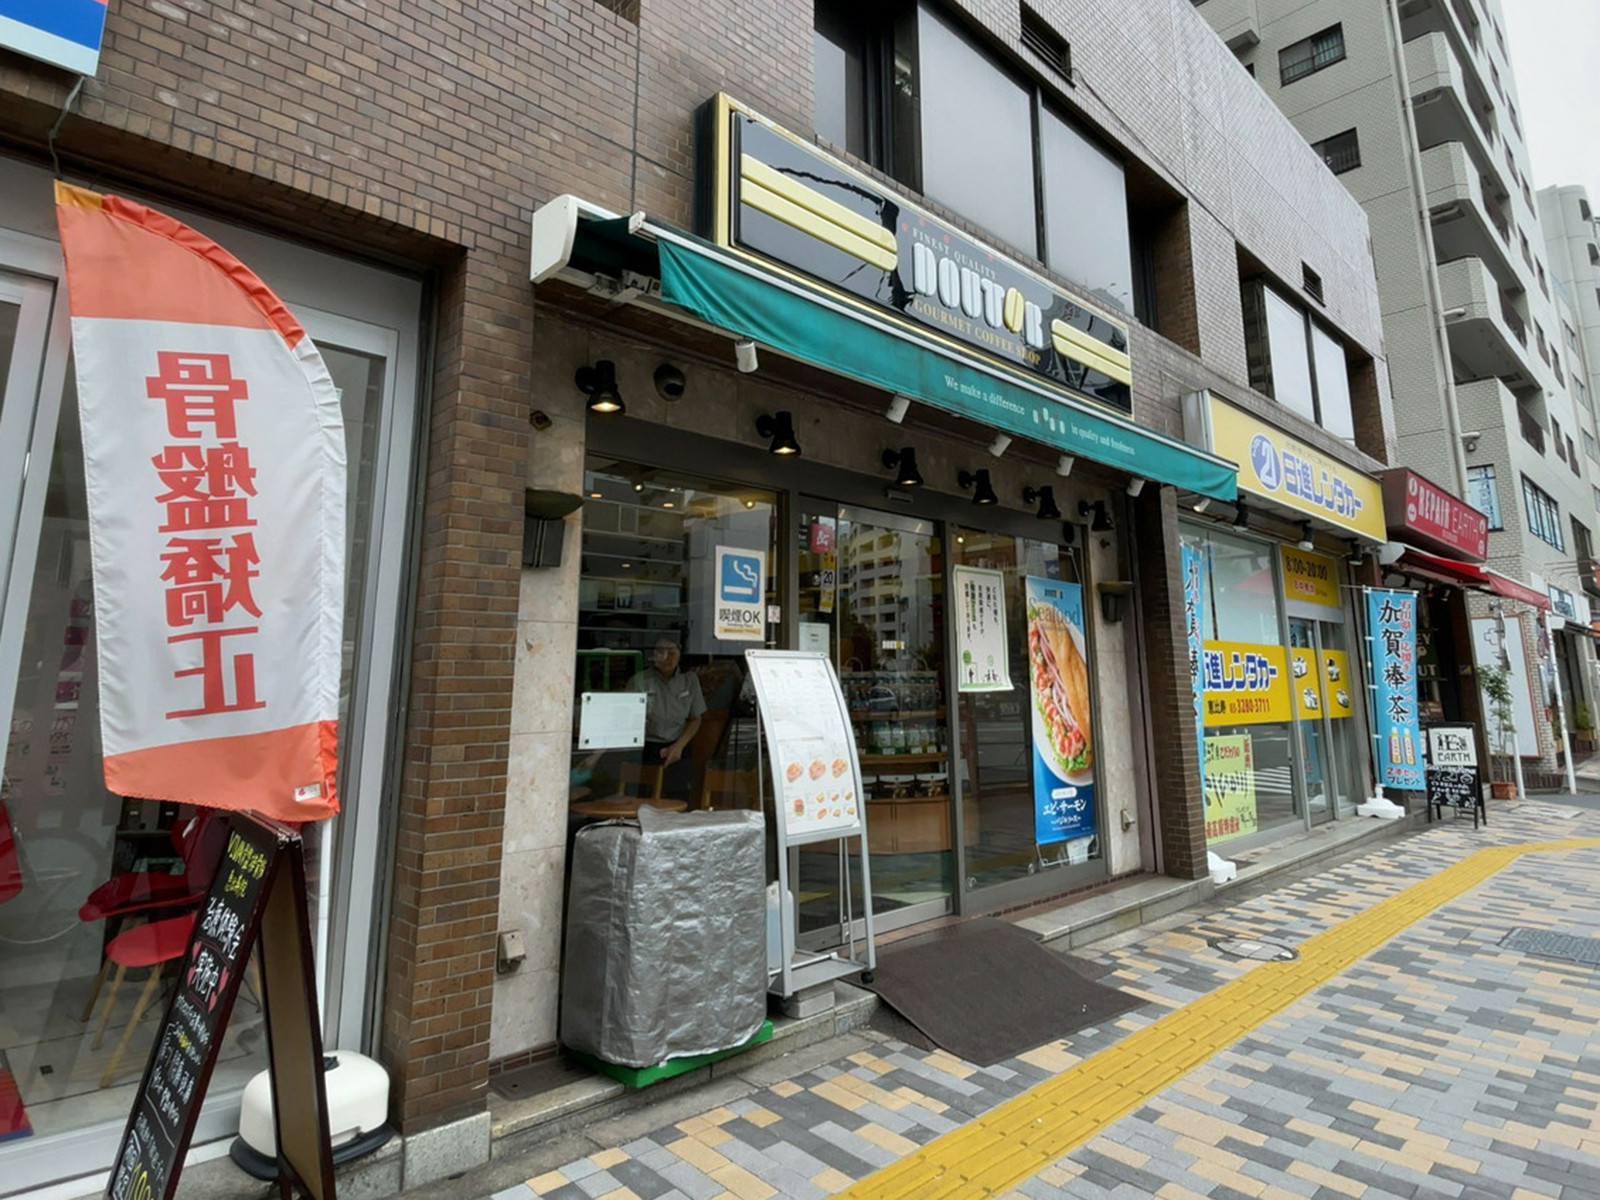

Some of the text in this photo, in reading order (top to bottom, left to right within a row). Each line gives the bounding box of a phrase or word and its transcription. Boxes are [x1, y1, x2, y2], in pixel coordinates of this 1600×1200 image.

[913, 228, 996, 280] FINEST QUALITY
[913, 242, 1043, 348] DOUTOR
[914, 301, 971, 334] GOURMET
[975, 328, 1014, 352] COFFEE
[944, 374, 958, 391] We
[960, 383, 982, 399] make
[988, 393, 1025, 416] difference
[1282, 450, 1362, 519] 日進レンタカー
[1418, 485, 1450, 529] REPAIR
[1452, 507, 1479, 542] EARTH
[1029, 597, 1081, 626] Seafood
[1203, 651, 1277, 690] 進レンタカー
[1378, 600, 1409, 724] 加賀棒茶
